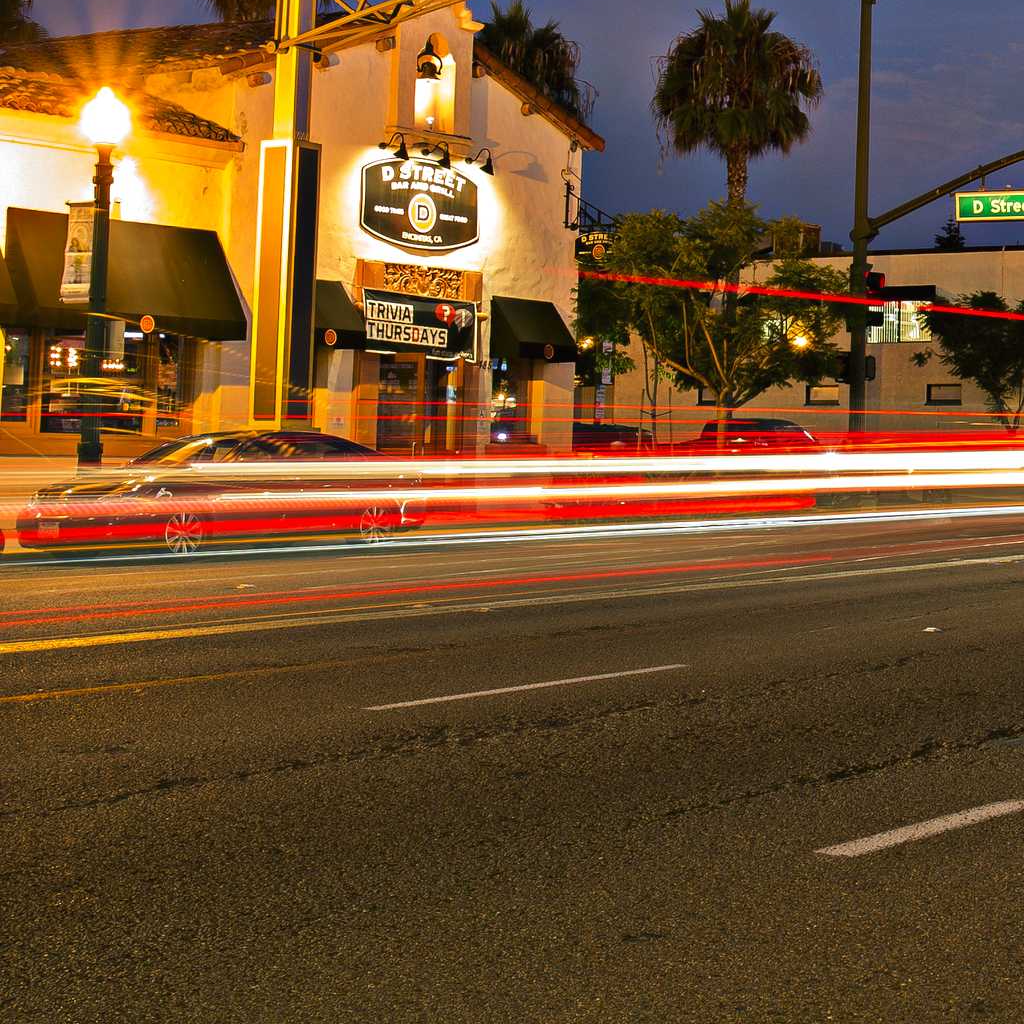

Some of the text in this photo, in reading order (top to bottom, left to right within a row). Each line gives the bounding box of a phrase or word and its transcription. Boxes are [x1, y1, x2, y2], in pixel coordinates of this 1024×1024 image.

[381, 161, 467, 192] D STREET
[972, 199, 984, 214] D
[367, 302, 412, 323] TRIVIA
[367, 321, 447, 346] THURSDAYS
